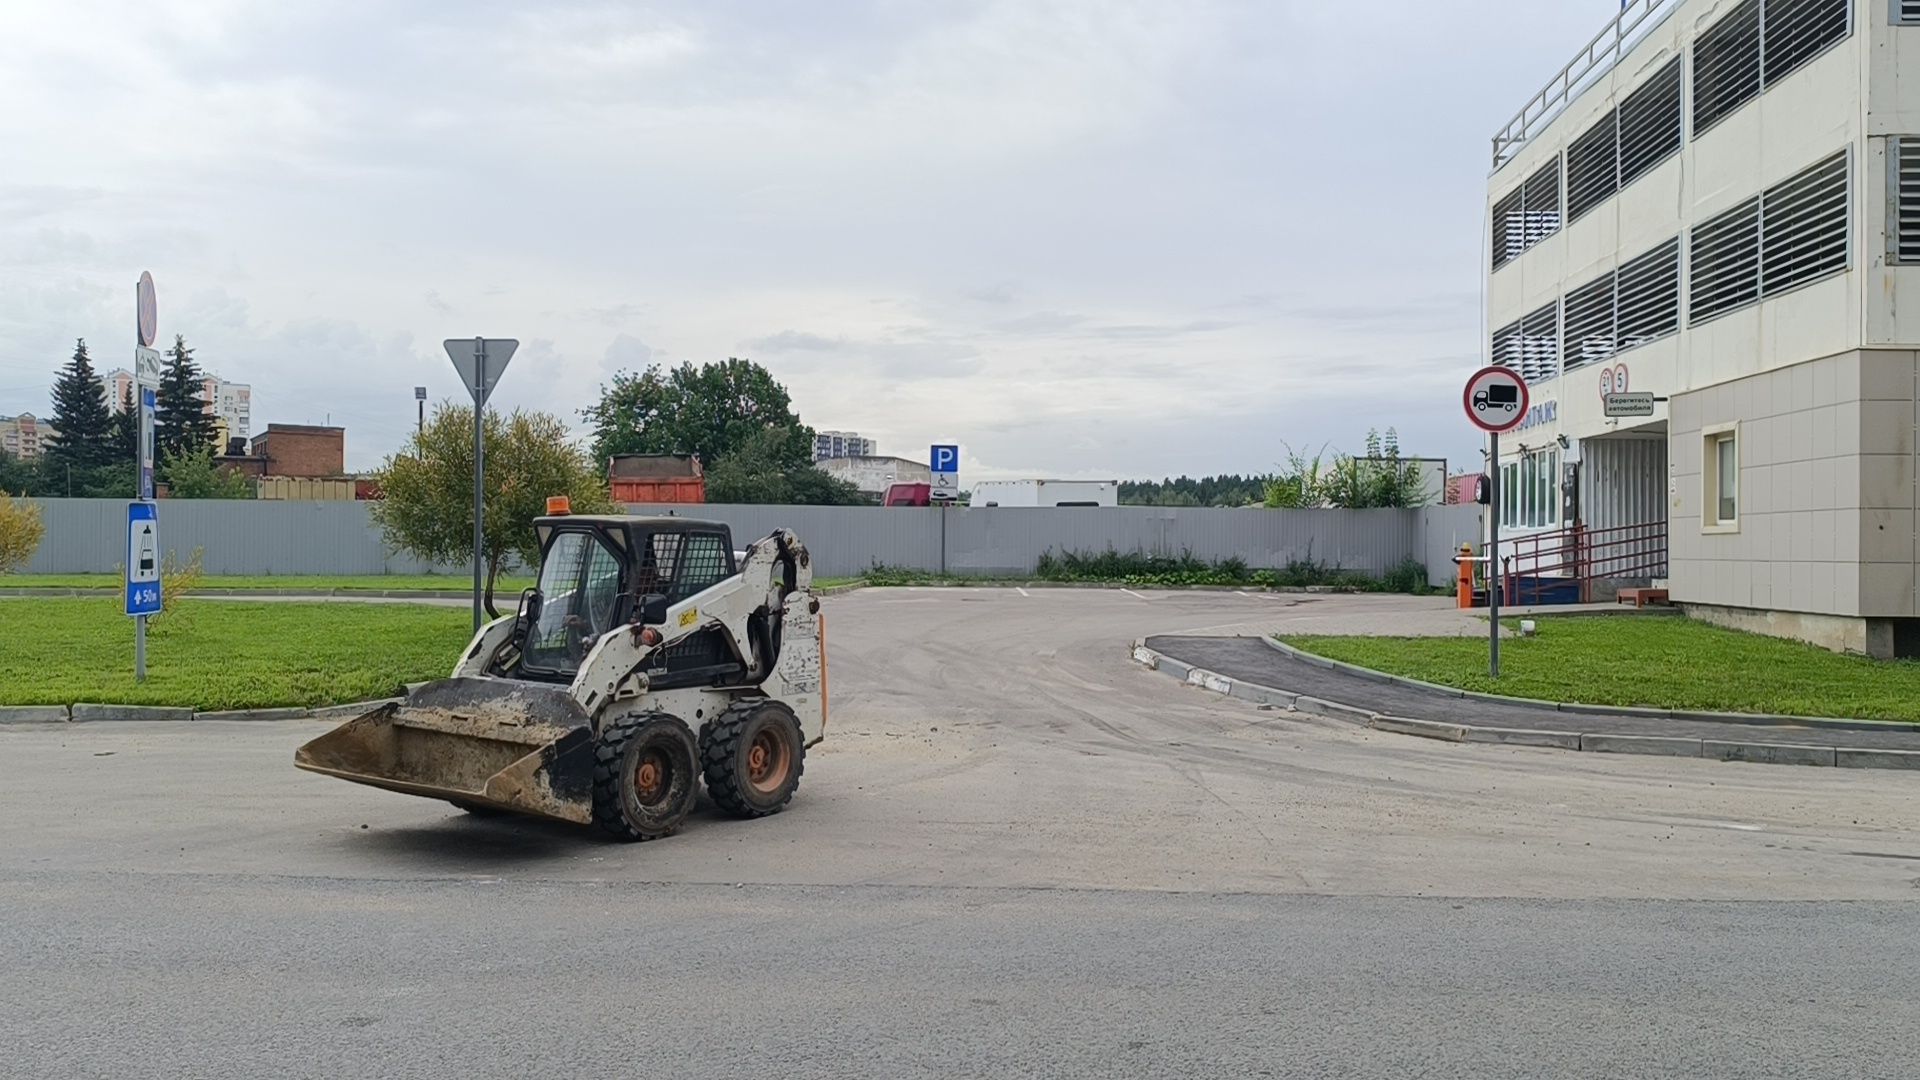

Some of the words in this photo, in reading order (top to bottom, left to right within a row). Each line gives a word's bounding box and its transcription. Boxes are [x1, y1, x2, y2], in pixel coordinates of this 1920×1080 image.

[1617, 372, 1623, 388] 5
[1608, 404, 1651, 412] автомобиля
[938, 449, 953, 470] P
